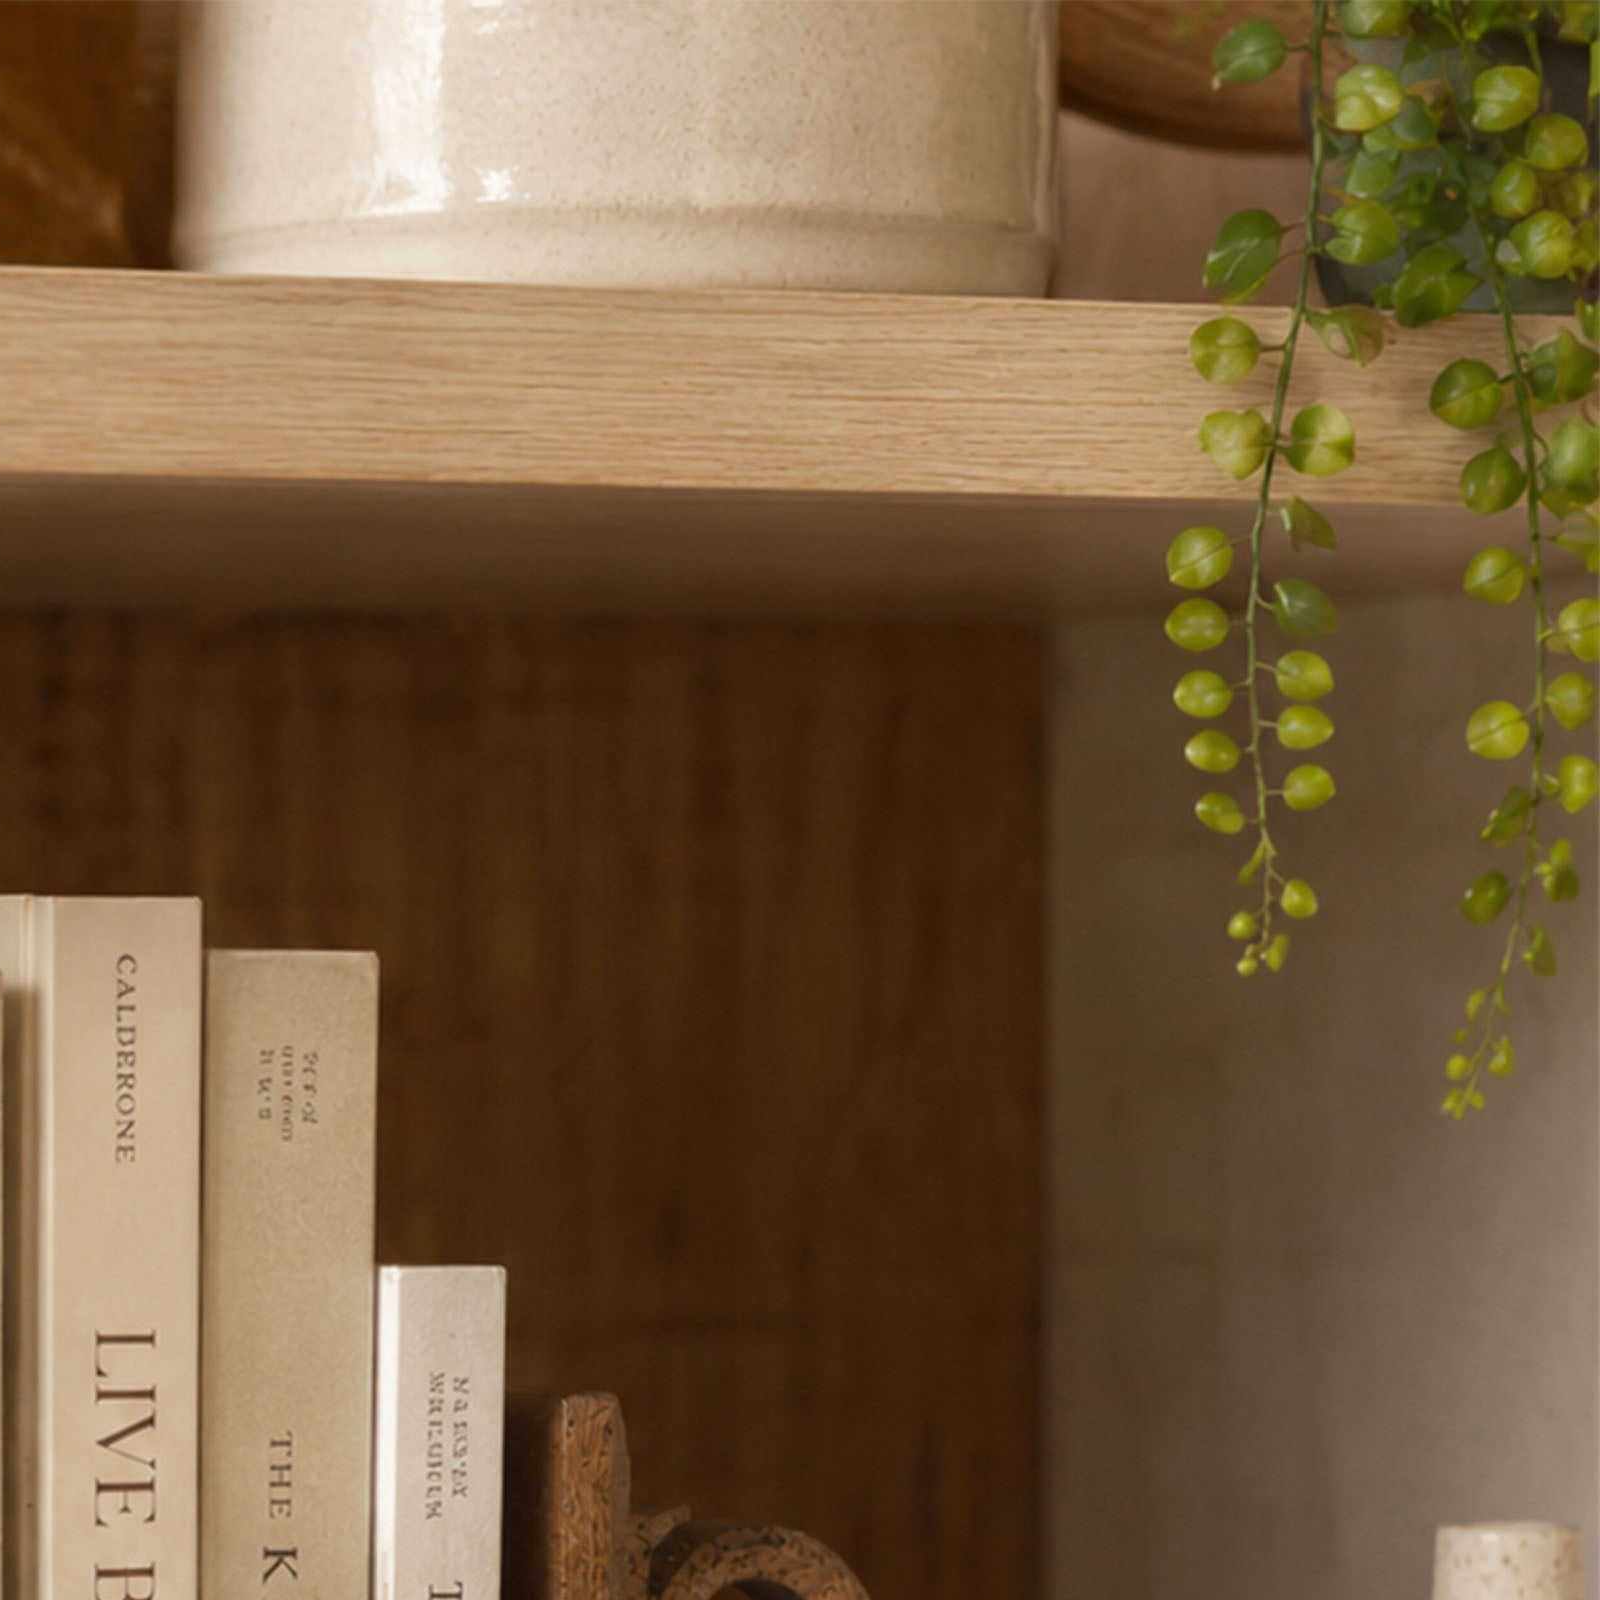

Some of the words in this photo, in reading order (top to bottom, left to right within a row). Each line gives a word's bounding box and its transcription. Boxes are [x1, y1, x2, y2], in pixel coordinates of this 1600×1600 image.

[116, 953, 137, 1164] CALDERONE
[94, 1331, 157, 1527] LIVE
[268, 1430, 293, 1519] THE
